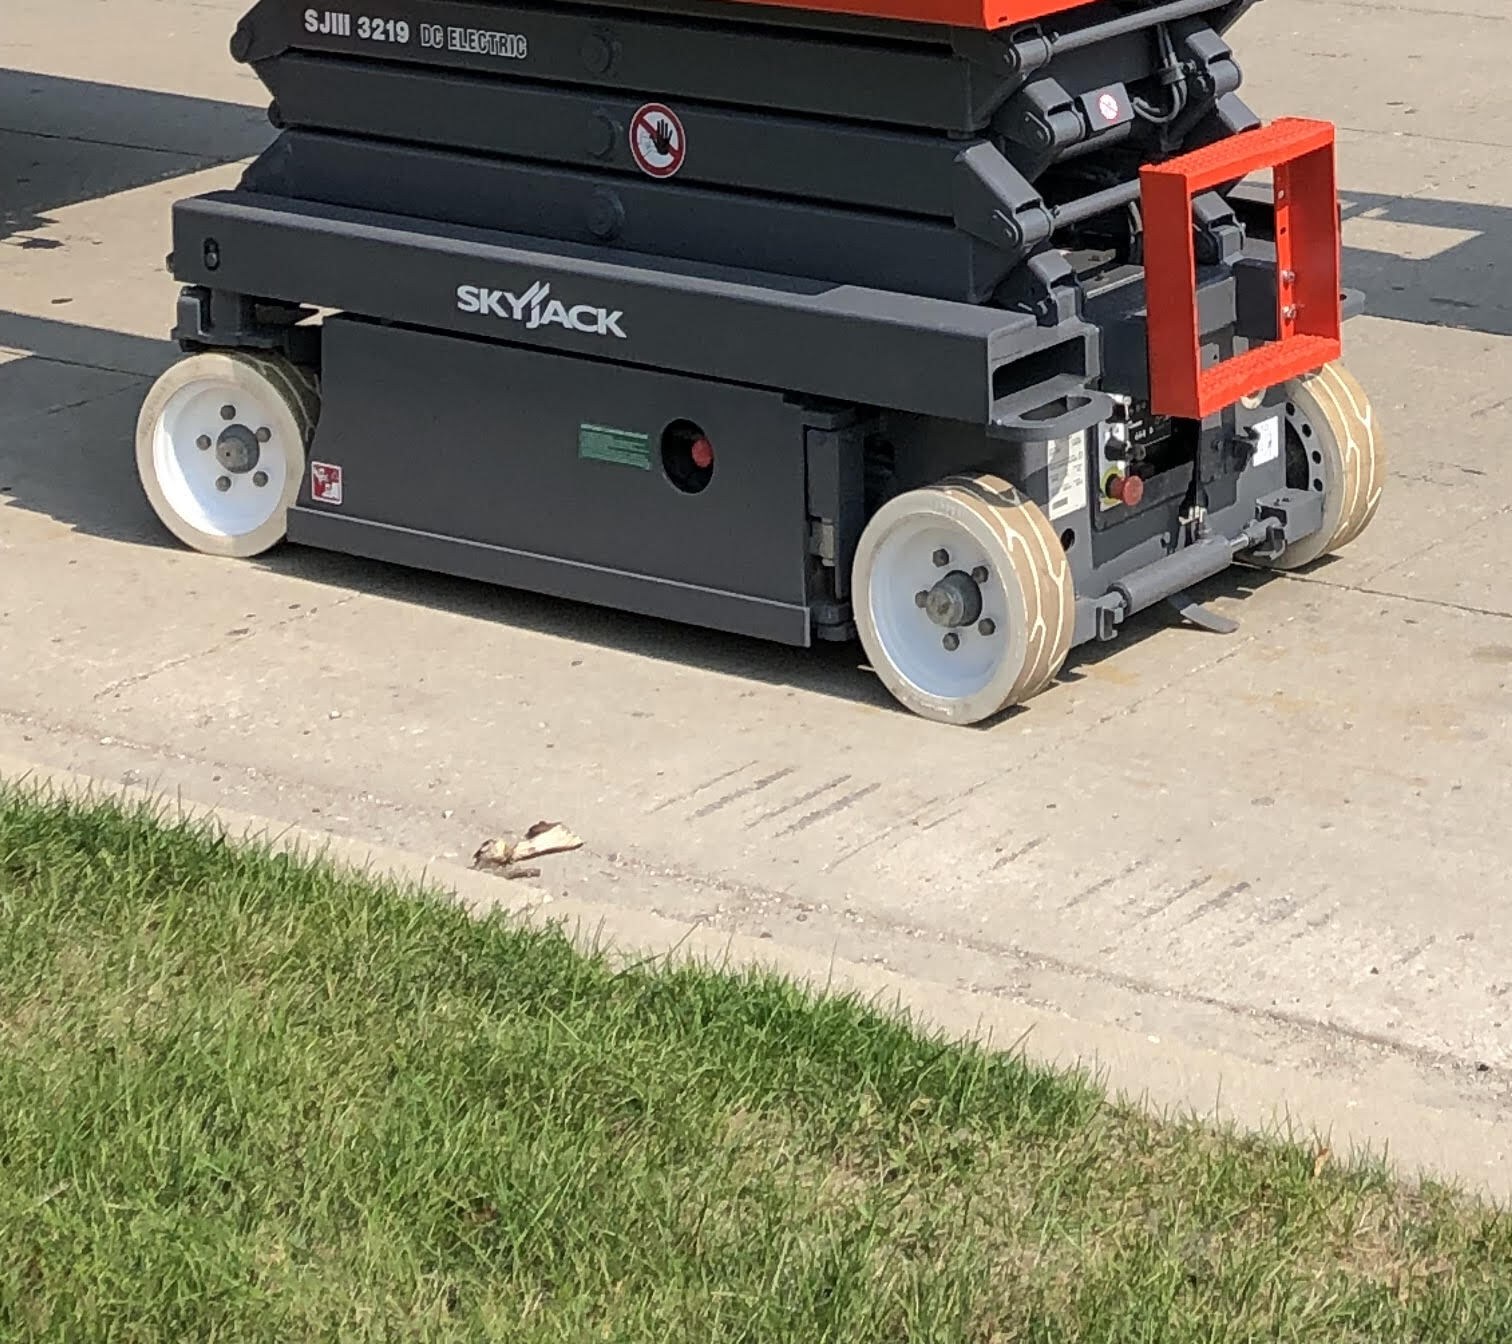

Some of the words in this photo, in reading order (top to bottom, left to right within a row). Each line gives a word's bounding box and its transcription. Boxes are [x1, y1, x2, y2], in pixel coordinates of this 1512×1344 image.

[304, 8, 351, 36] SJIII
[357, 16, 410, 44] 3219
[420, 23, 444, 49] DC
[448, 27, 527, 59] ELECTRIC
[457, 281, 627, 338] SKYJACK
